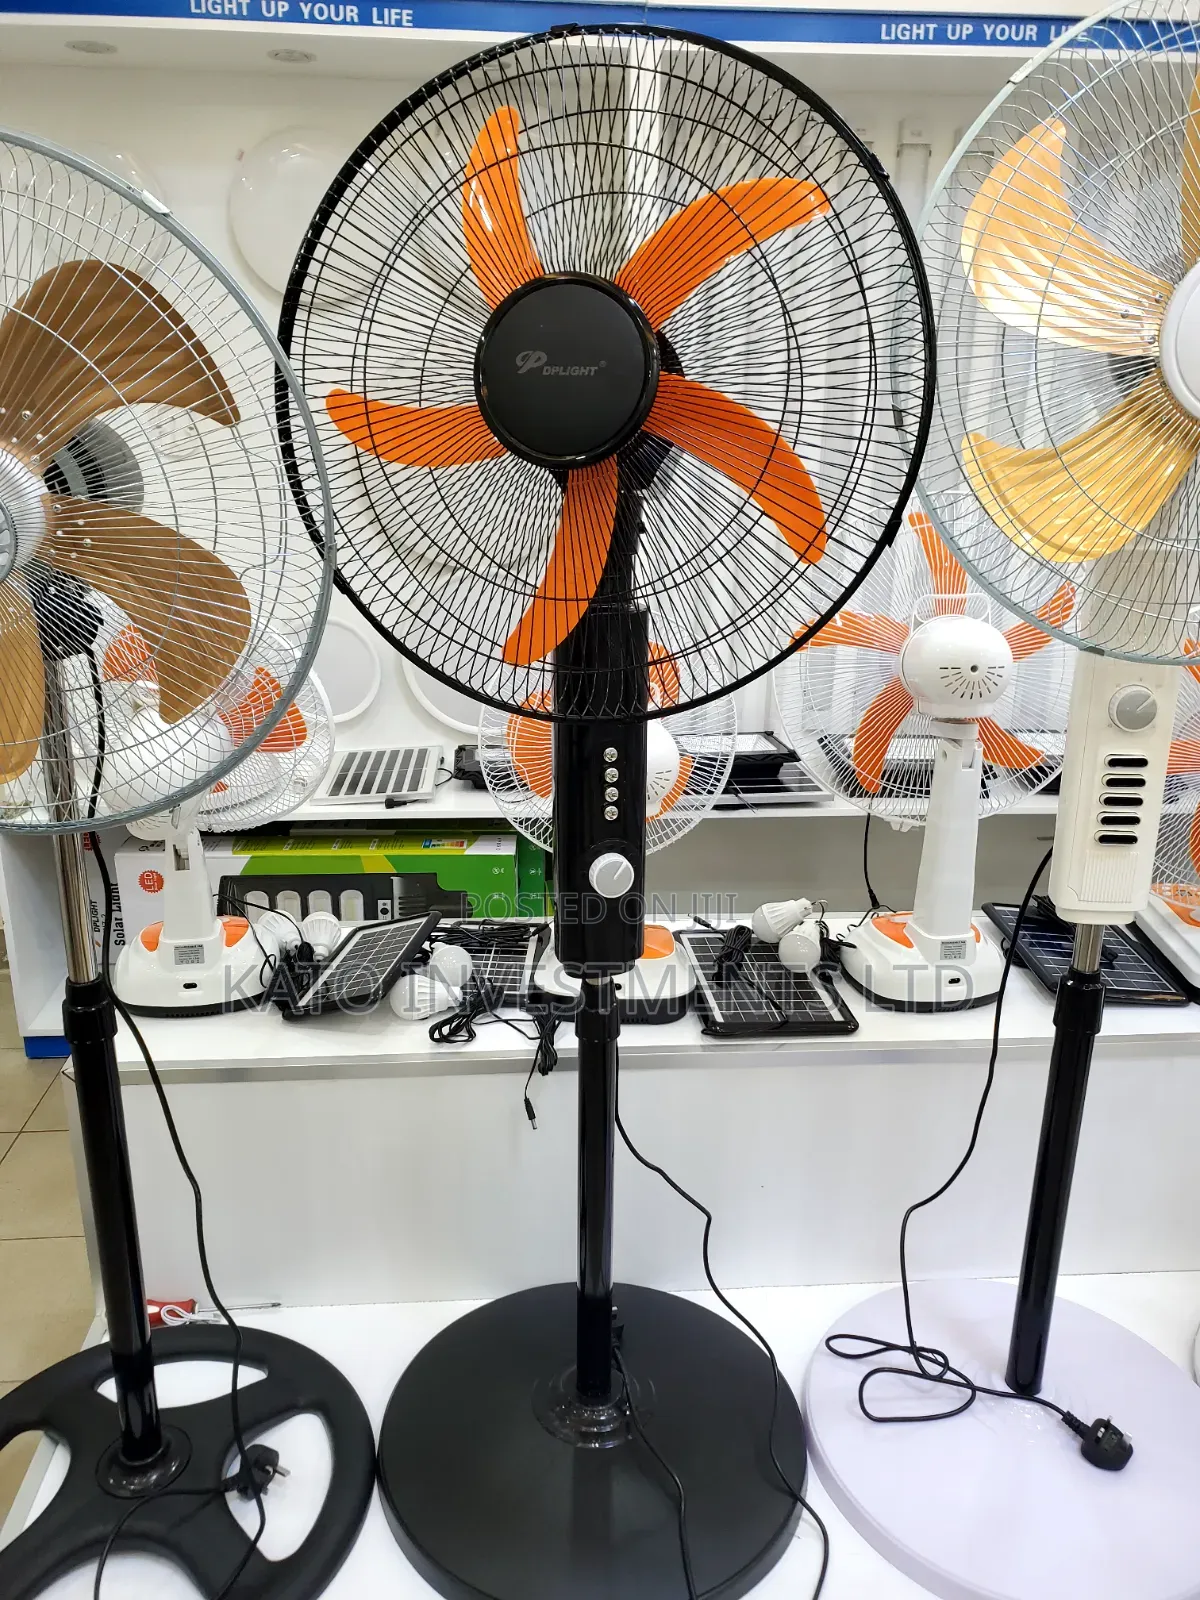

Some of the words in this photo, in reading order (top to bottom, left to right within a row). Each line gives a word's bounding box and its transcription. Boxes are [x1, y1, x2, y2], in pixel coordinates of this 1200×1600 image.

[190, 0, 249, 16] LIGHT
[261, 0, 290, 18] UP
[300, 4, 359, 23] YOUR
[371, 7, 414, 27] LIFE
[880, 23, 938, 41] LIGHT
[947, 23, 974, 41] UP
[983, 24, 1038, 42] YOUR
[542, 366, 599, 376] DPLIGHT
[143, 872, 154, 891] LED
[114, 917, 126, 946] Solar
